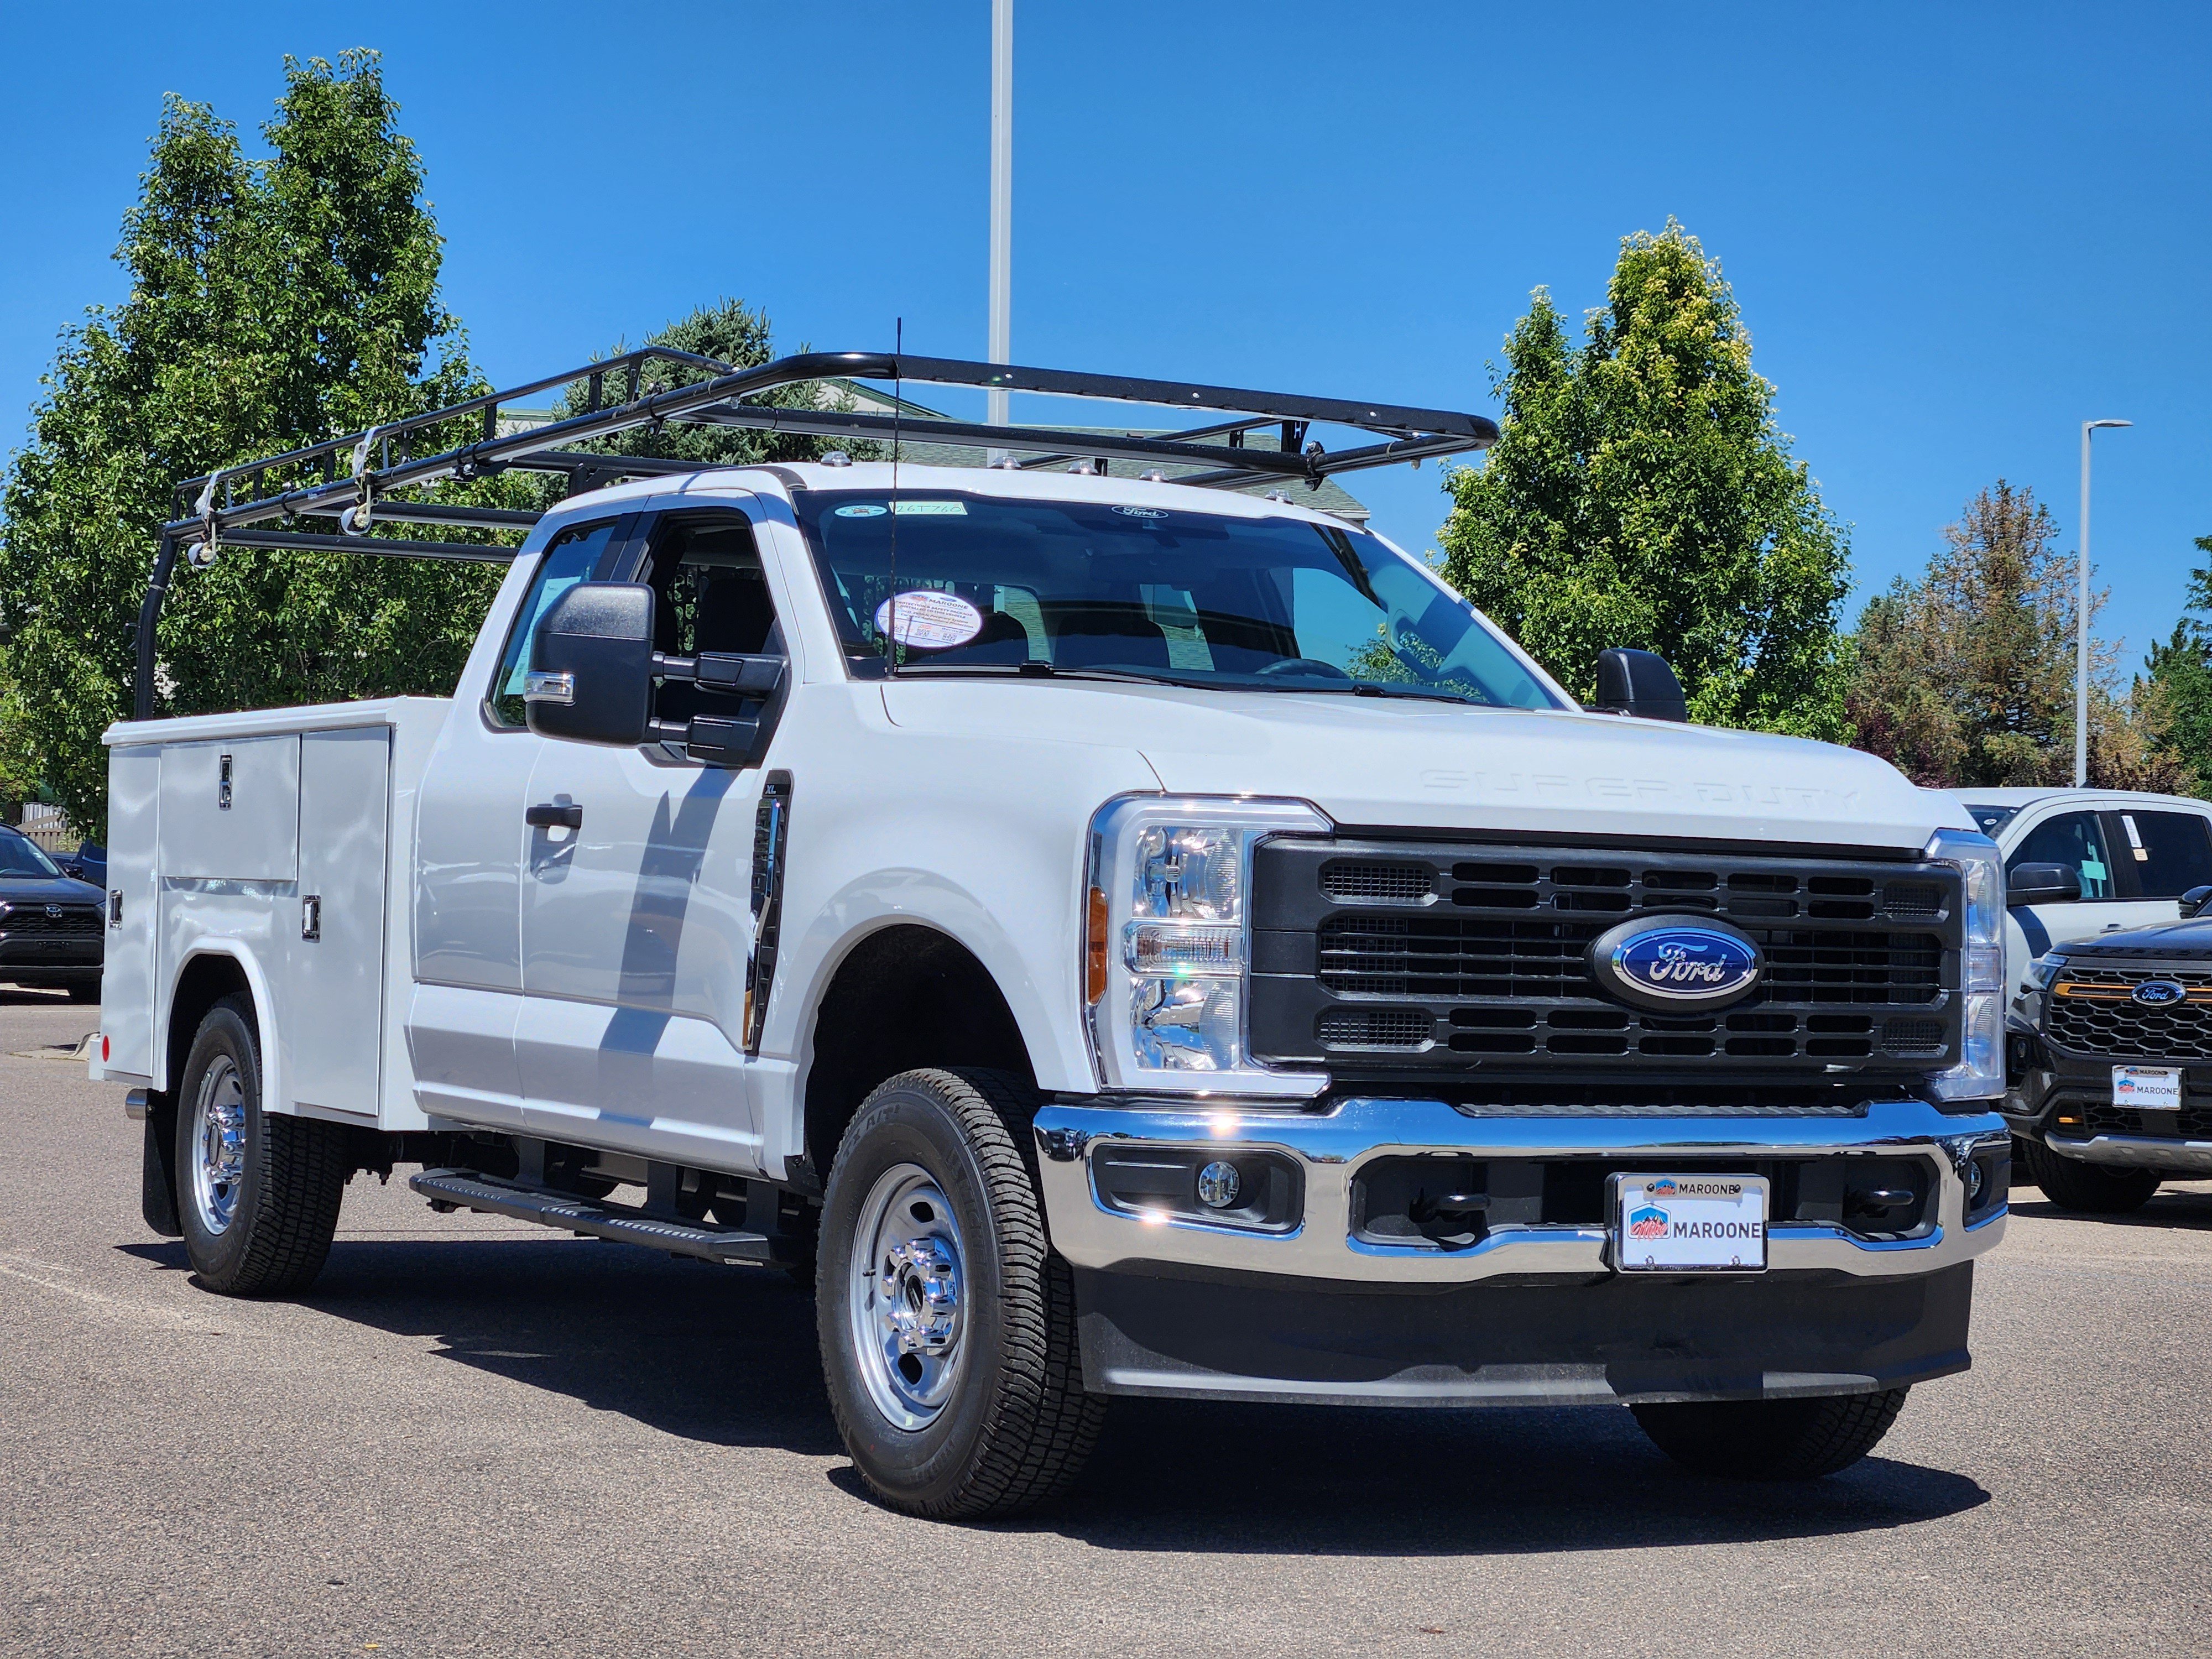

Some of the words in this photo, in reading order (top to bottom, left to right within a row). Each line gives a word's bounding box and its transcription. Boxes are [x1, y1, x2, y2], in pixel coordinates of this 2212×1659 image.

[1123, 507, 1159, 517] Ford
[929, 599, 969, 609] MAROONE
[765, 785, 776, 794] XL
[1418, 769, 1680, 799] SUPER
[1693, 781, 1861, 812] DUTY
[1649, 942, 1728, 982] Ford
[2141, 986, 2169, 1000] Ford
[2137, 1087, 2179, 1095] MAROONE
[1679, 1184, 1735, 1194] MAROONE
[1673, 1222, 1761, 1238] MAROONE
